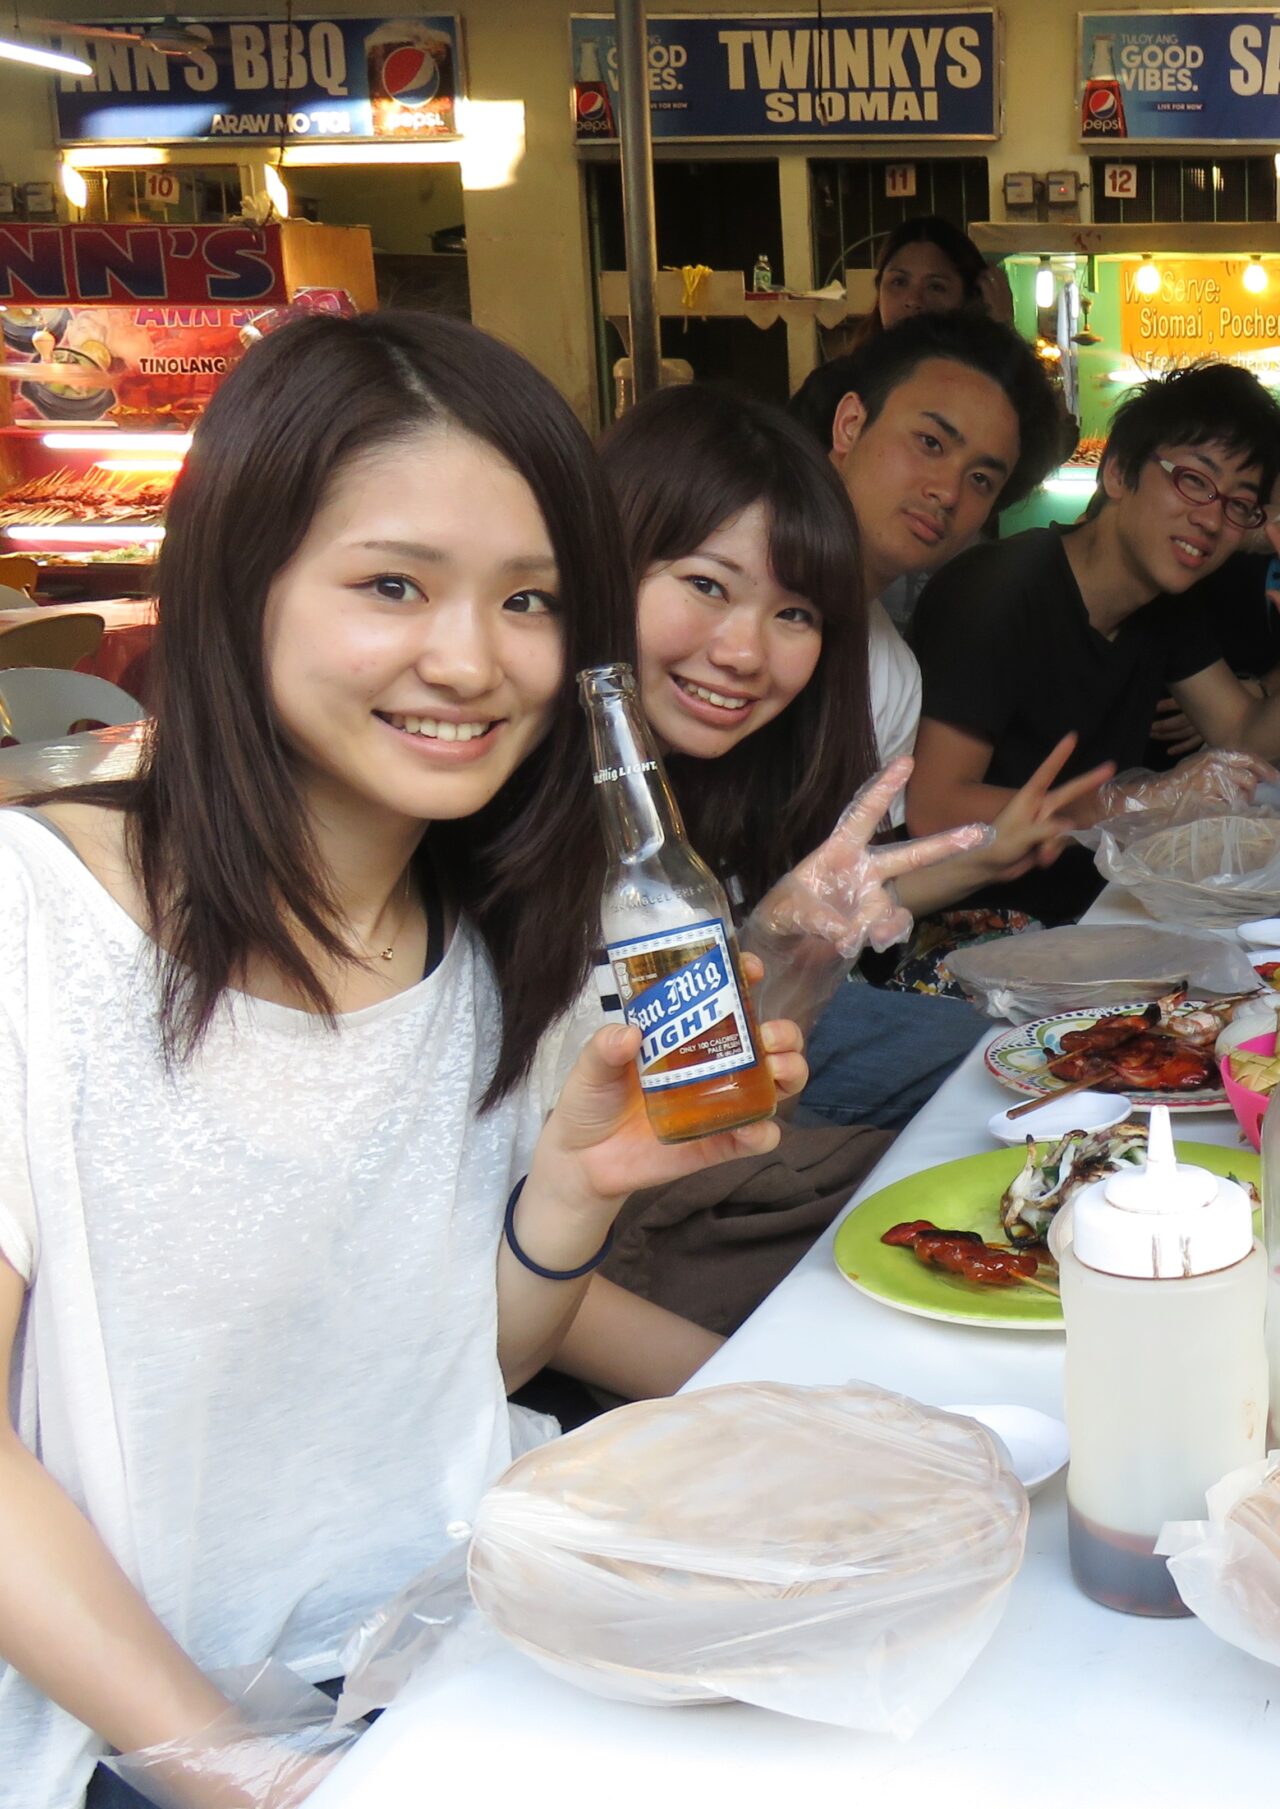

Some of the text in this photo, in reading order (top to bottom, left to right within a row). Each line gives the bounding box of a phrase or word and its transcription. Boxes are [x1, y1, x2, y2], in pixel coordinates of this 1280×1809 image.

[1121, 34, 1179, 45] TULOY ANG
[60, 22, 349, 96] ANNS BBQ
[718, 26, 982, 91] TWINKYS
[1121, 45, 1204, 68] GOOD
[1121, 68, 1199, 92] VIBES.
[764, 91, 939, 123] SIOMAI
[210, 113, 270, 134] ARAW
[1083, 117, 1122, 132] pepsi
[148, 175, 173, 197] 10
[888, 168, 908, 190] 11
[1109, 169, 1131, 193] 12
[1161, 271, 1221, 304] Serve:
[139, 356, 226, 375] TINOLANG
[663, 960, 722, 1015] Mig
[640, 998, 720, 1064] LIGHT
